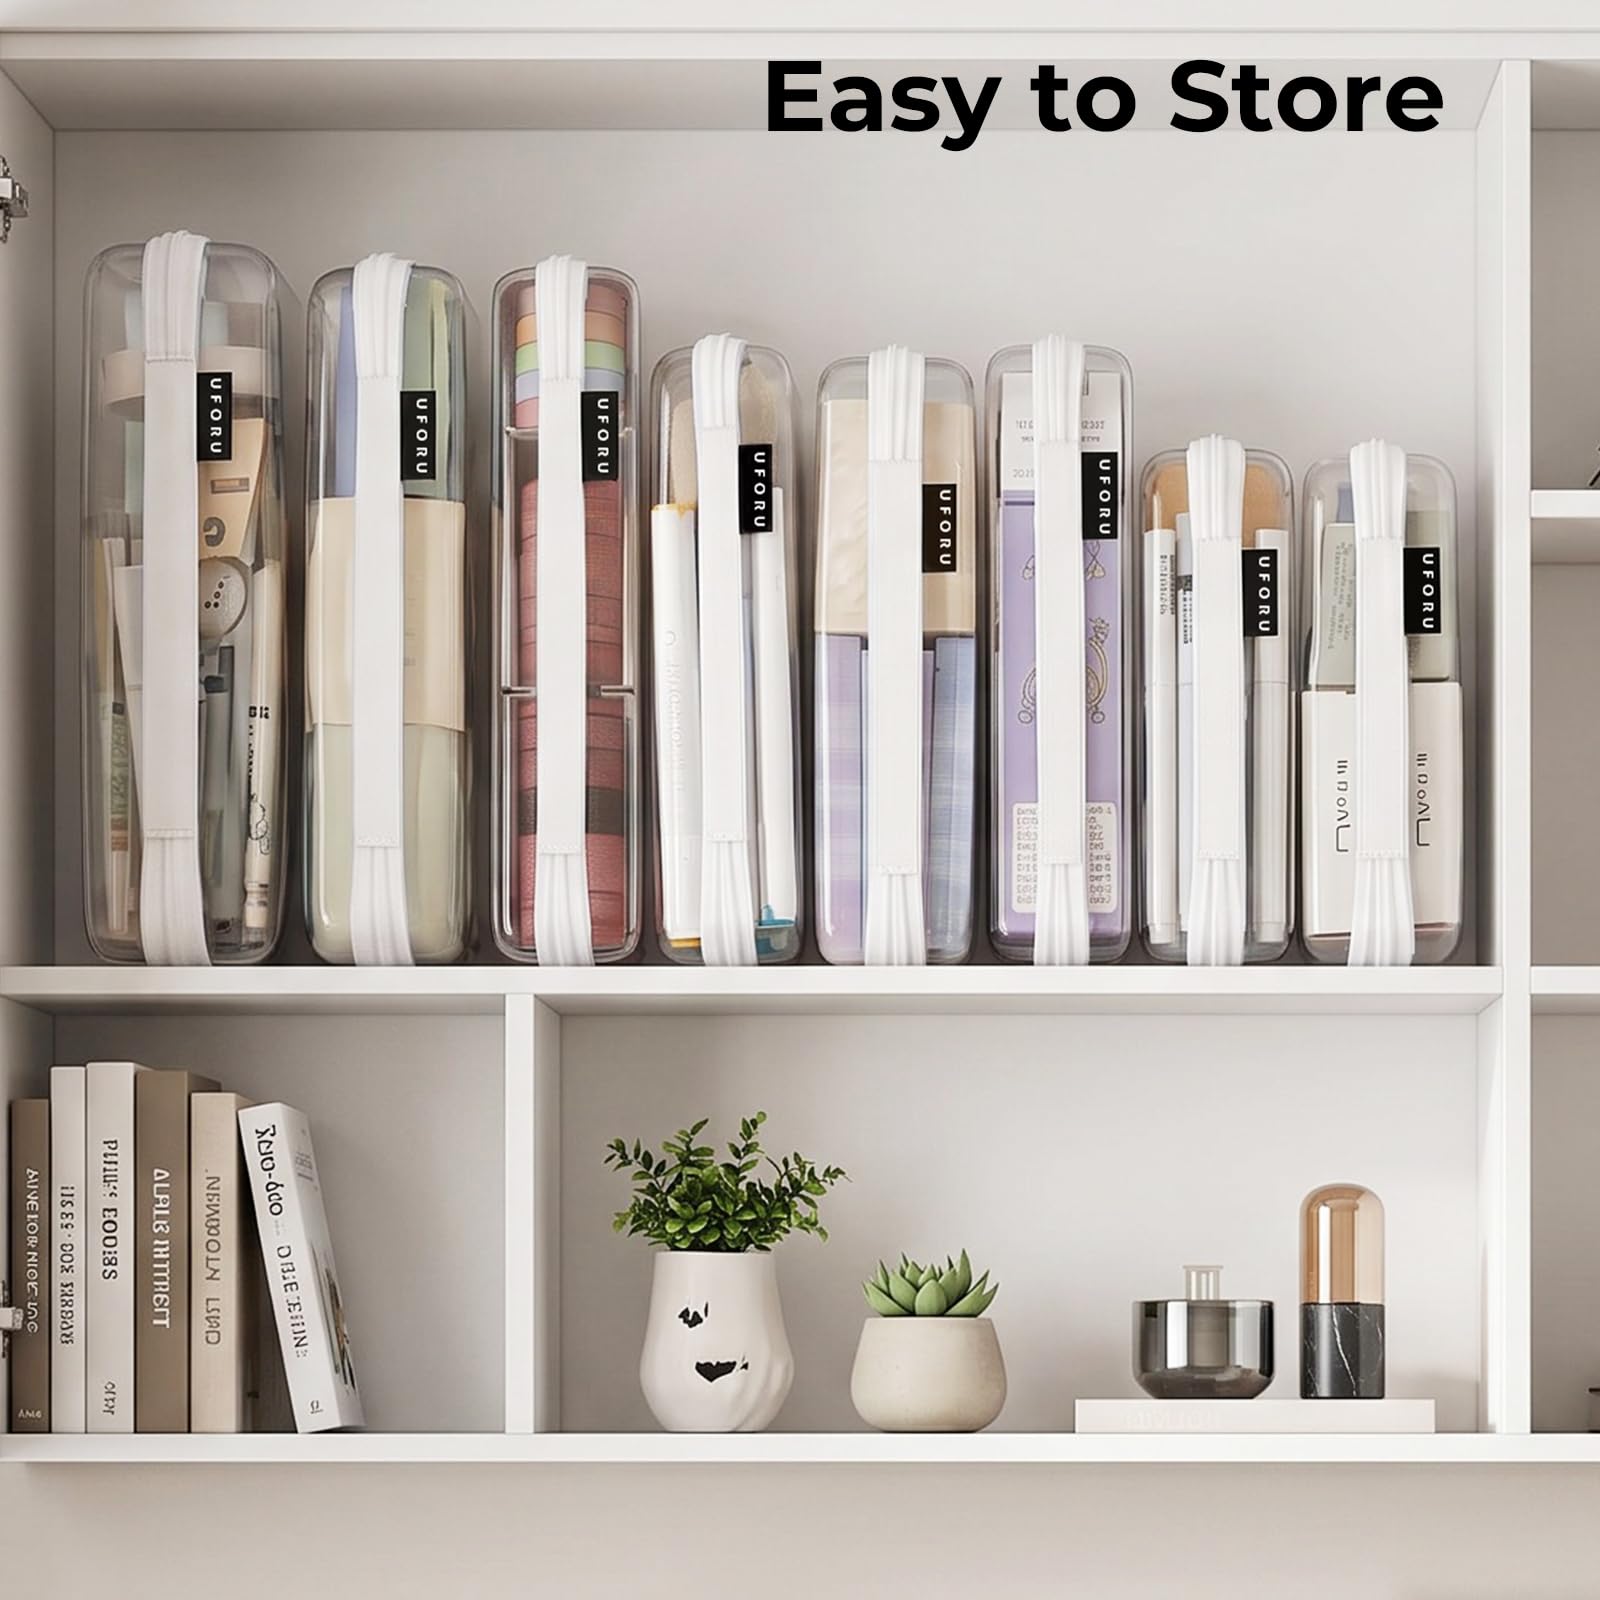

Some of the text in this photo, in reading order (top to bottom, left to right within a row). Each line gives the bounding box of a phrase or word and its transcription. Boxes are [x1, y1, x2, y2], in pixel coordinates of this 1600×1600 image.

[210, 377, 222, 453] UFORU
[416, 398, 428, 474] UFORU
[597, 398, 610, 474] UFORU
[753, 451, 766, 527] UFORU
[939, 489, 952, 565] UFORU
[1098, 459, 1111, 534] UFORU
[1258, 556, 1271, 632] UFORU
[1422, 553, 1435, 629] UFORU
